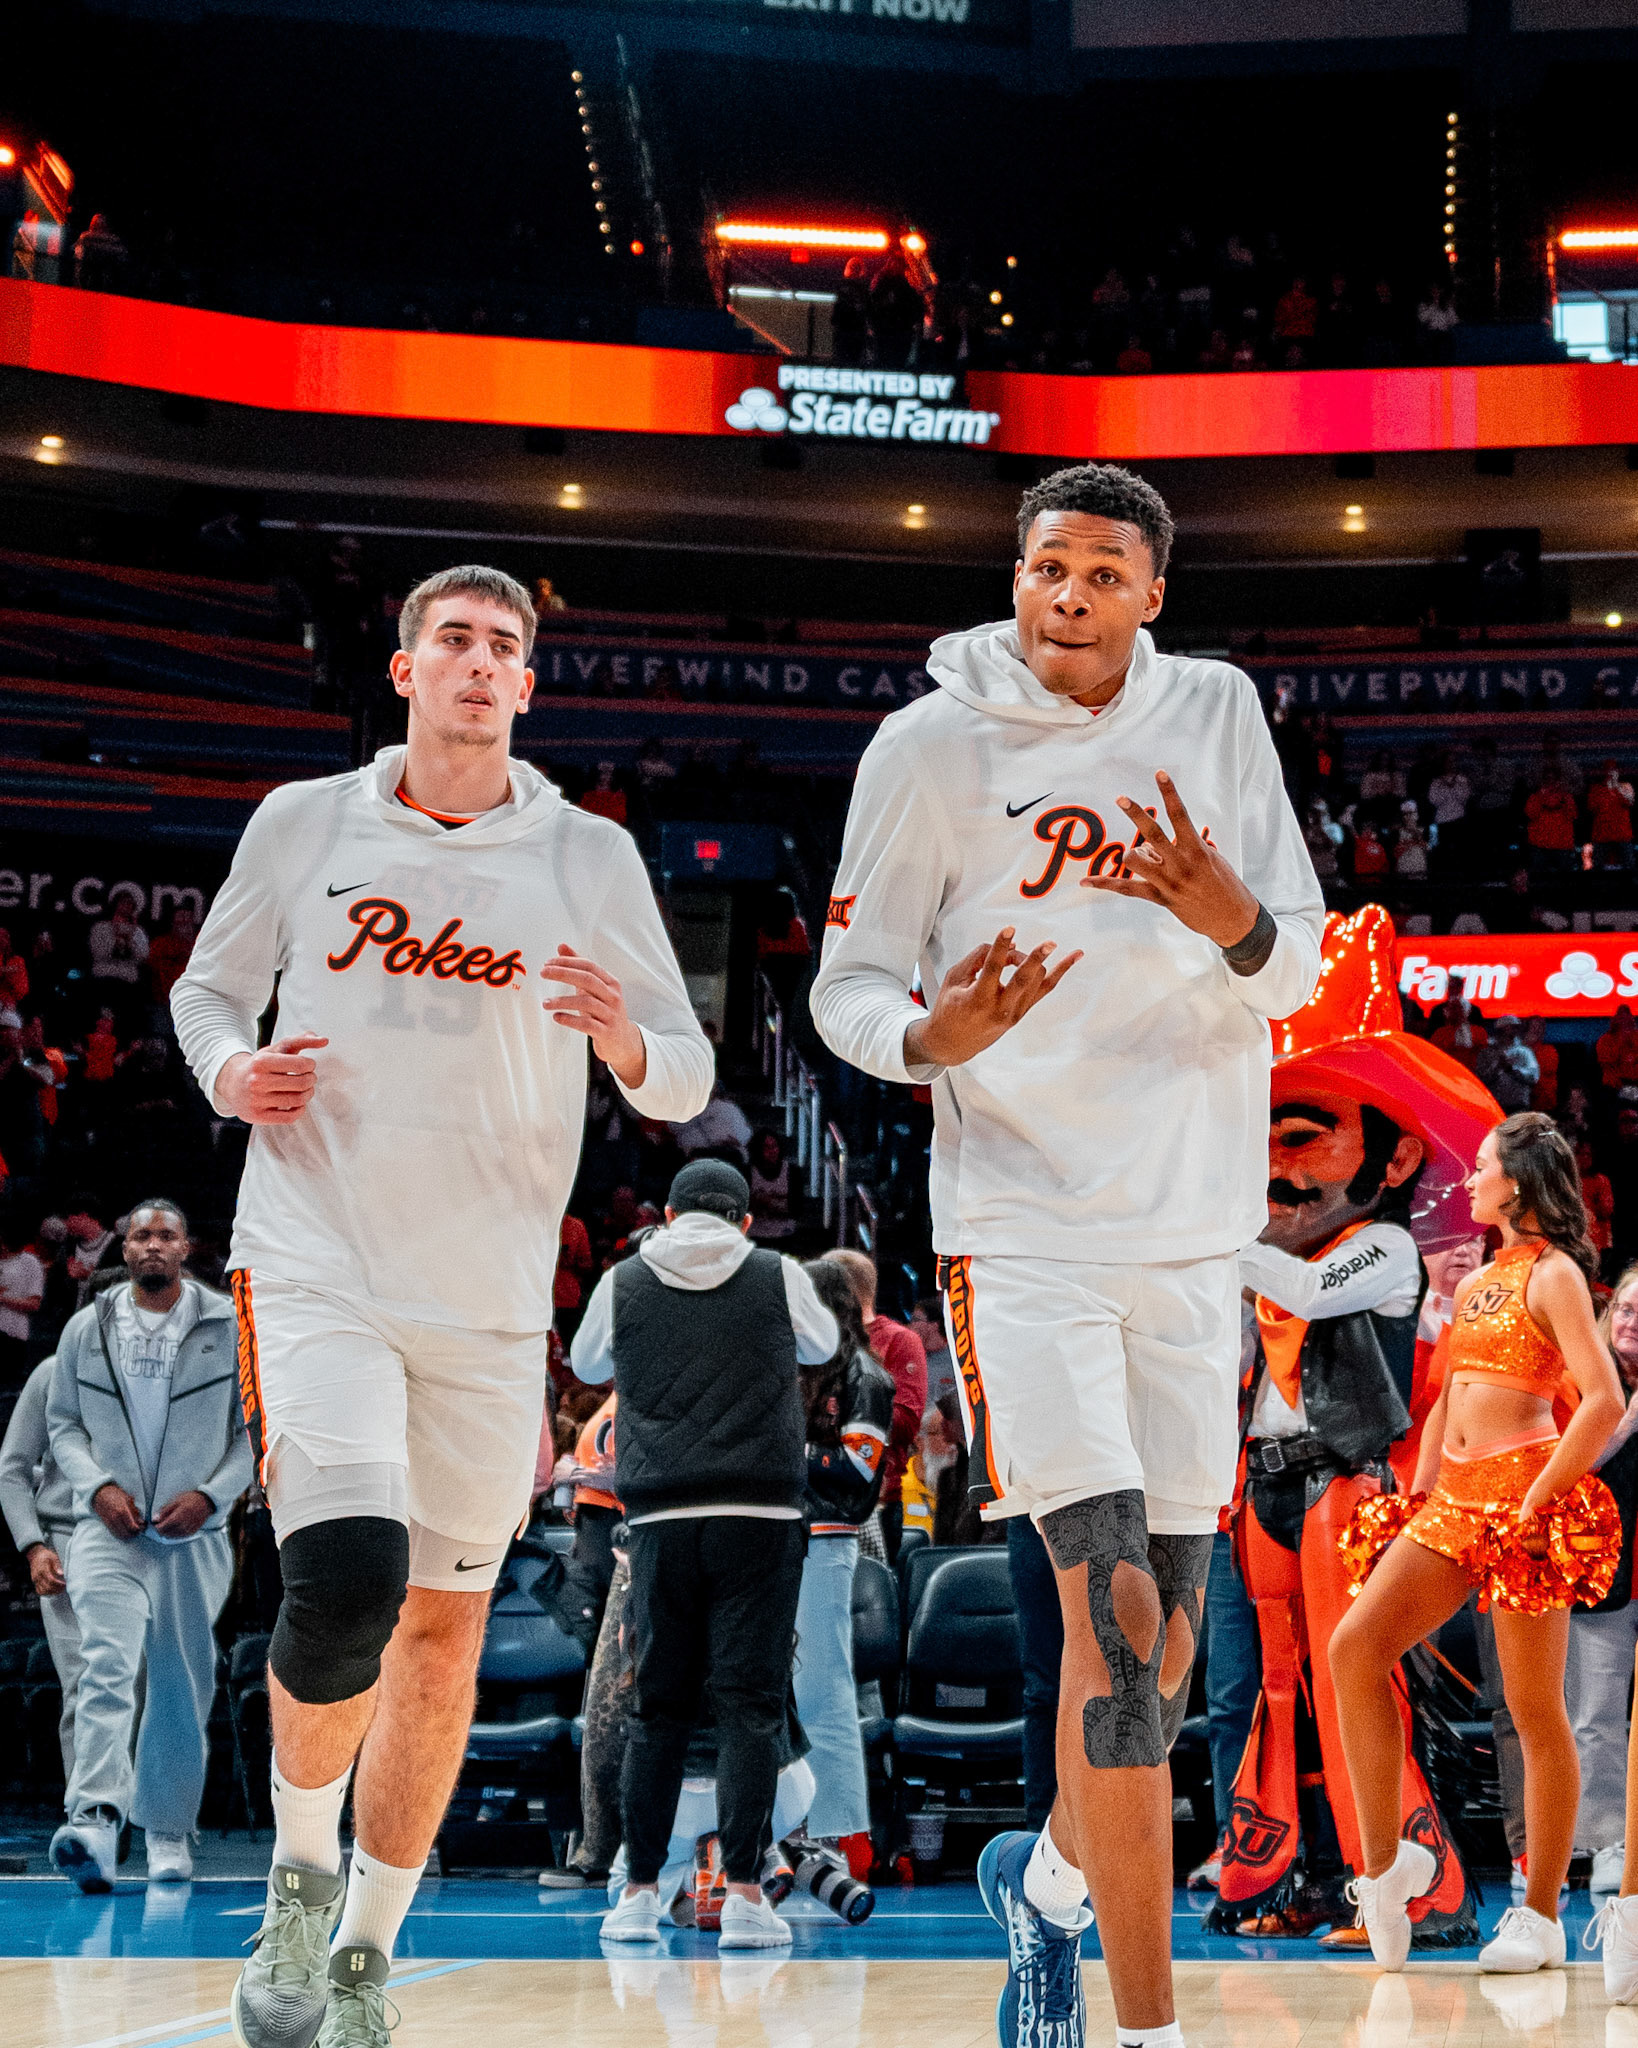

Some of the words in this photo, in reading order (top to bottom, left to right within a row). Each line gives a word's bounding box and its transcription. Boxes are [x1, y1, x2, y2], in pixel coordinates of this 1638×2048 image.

[872, 0, 971, 23] NOW
[778, 365, 918, 398] PRESENTED
[918, 374, 956, 400] BY
[531, 651, 809, 694] IVEWIND
[326, 896, 527, 988] Pokes
[1320, 1243, 1388, 1291] Wrangler
